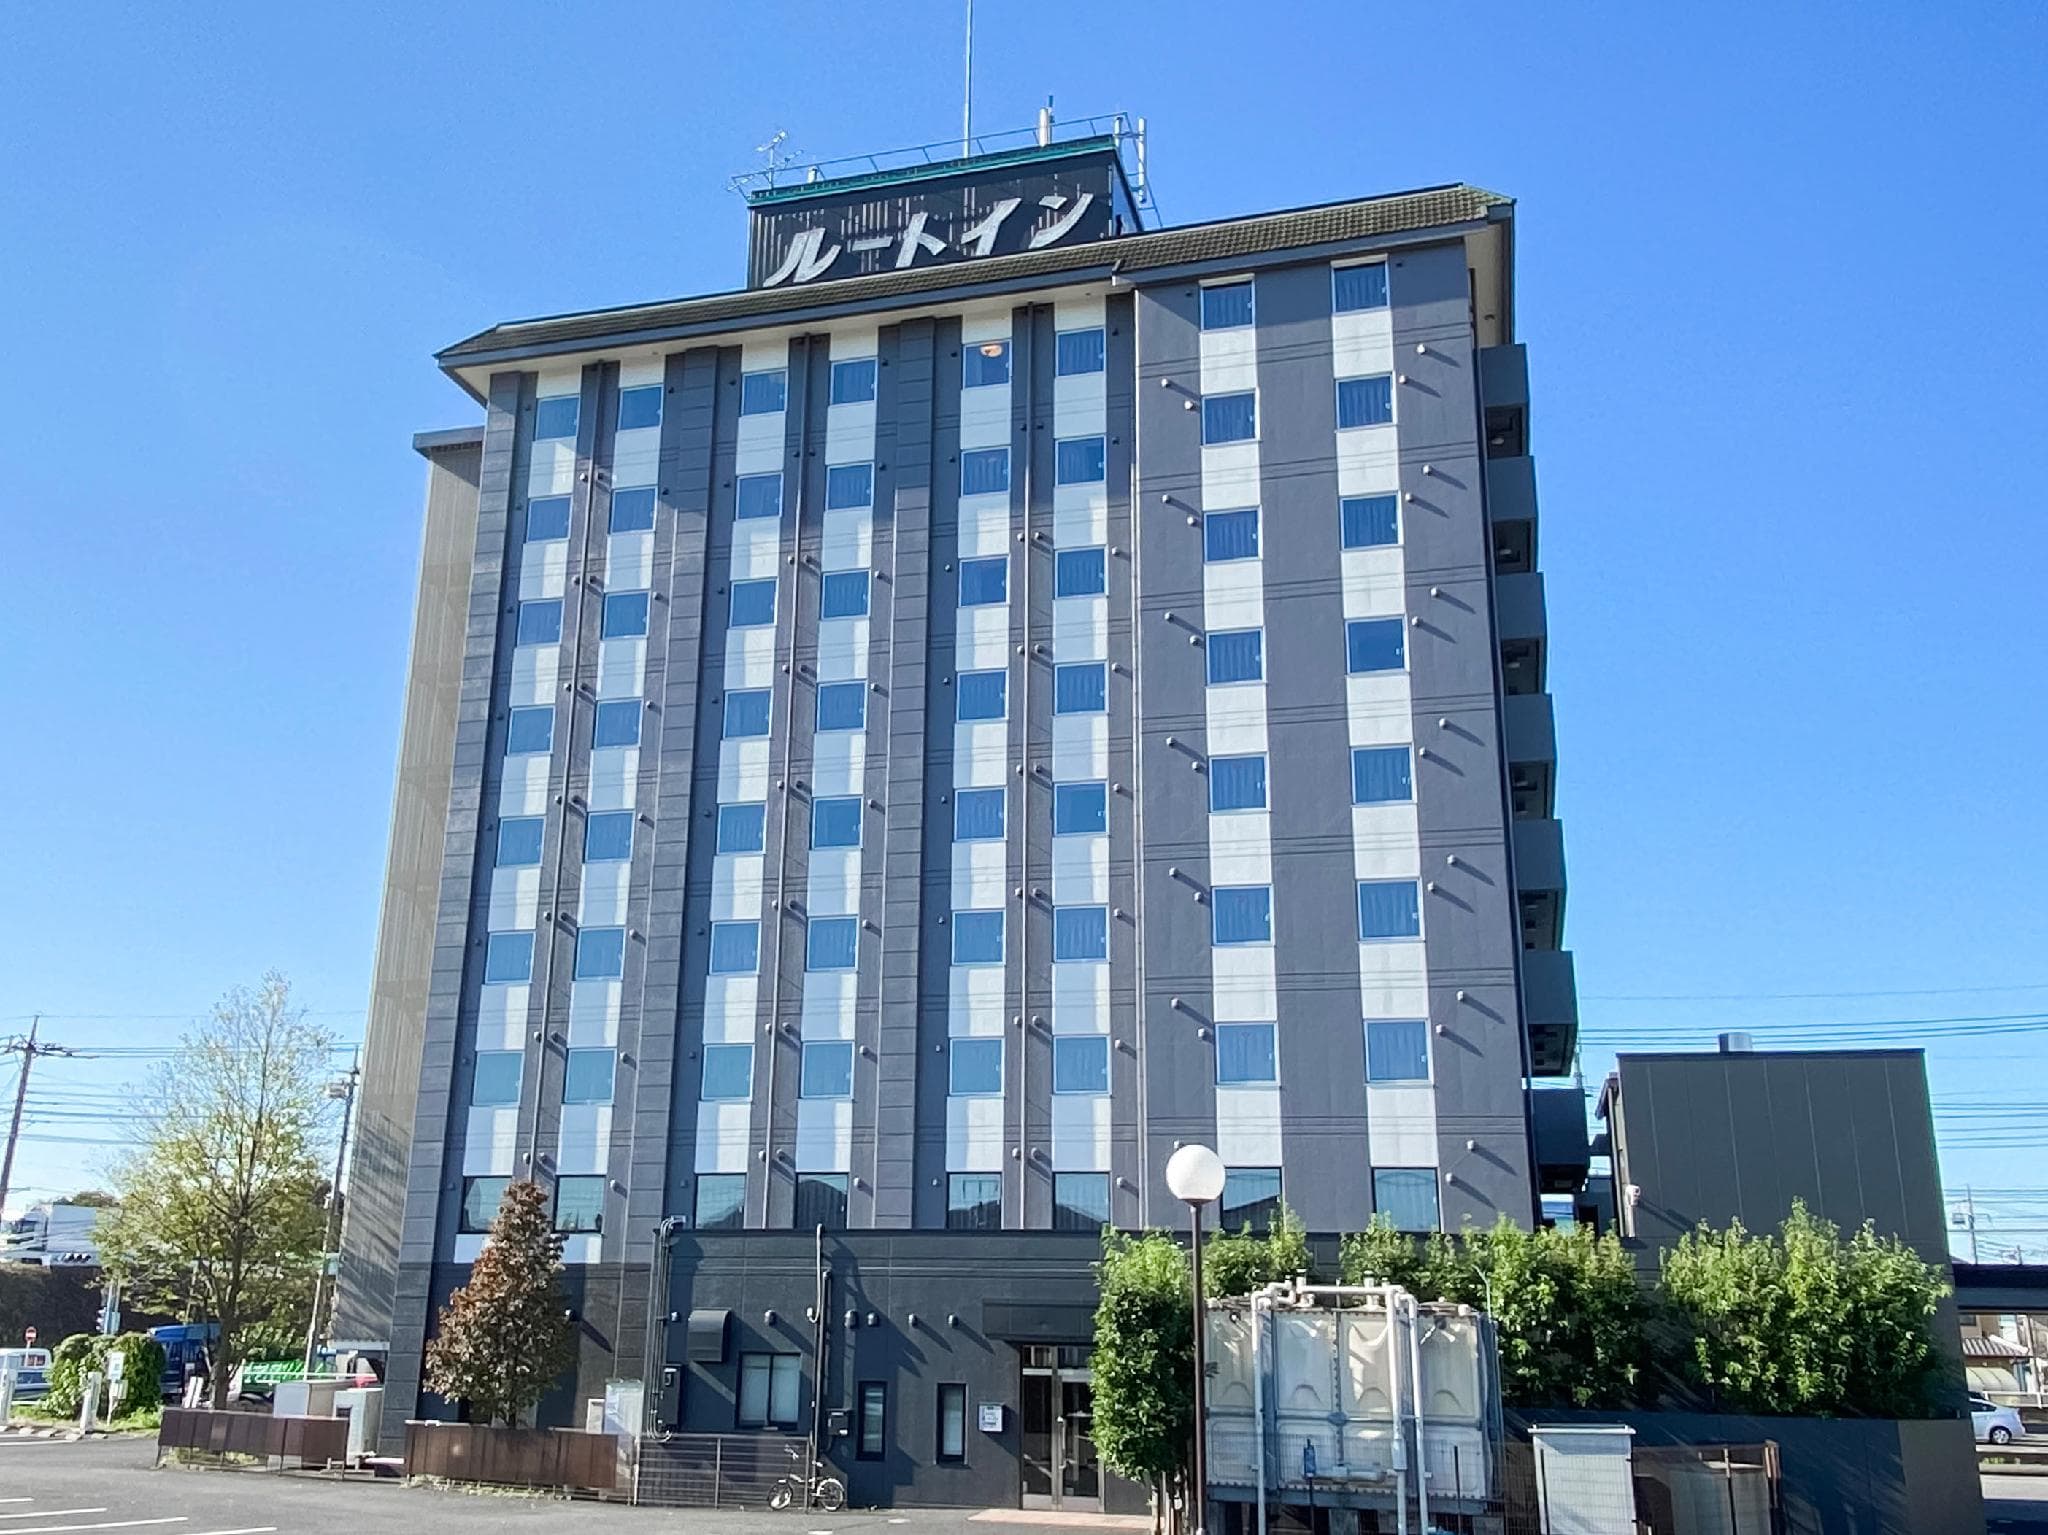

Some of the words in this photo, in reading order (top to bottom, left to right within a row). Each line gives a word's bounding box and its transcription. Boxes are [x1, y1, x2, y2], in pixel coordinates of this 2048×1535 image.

[762, 193, 1094, 287] ルートイン
